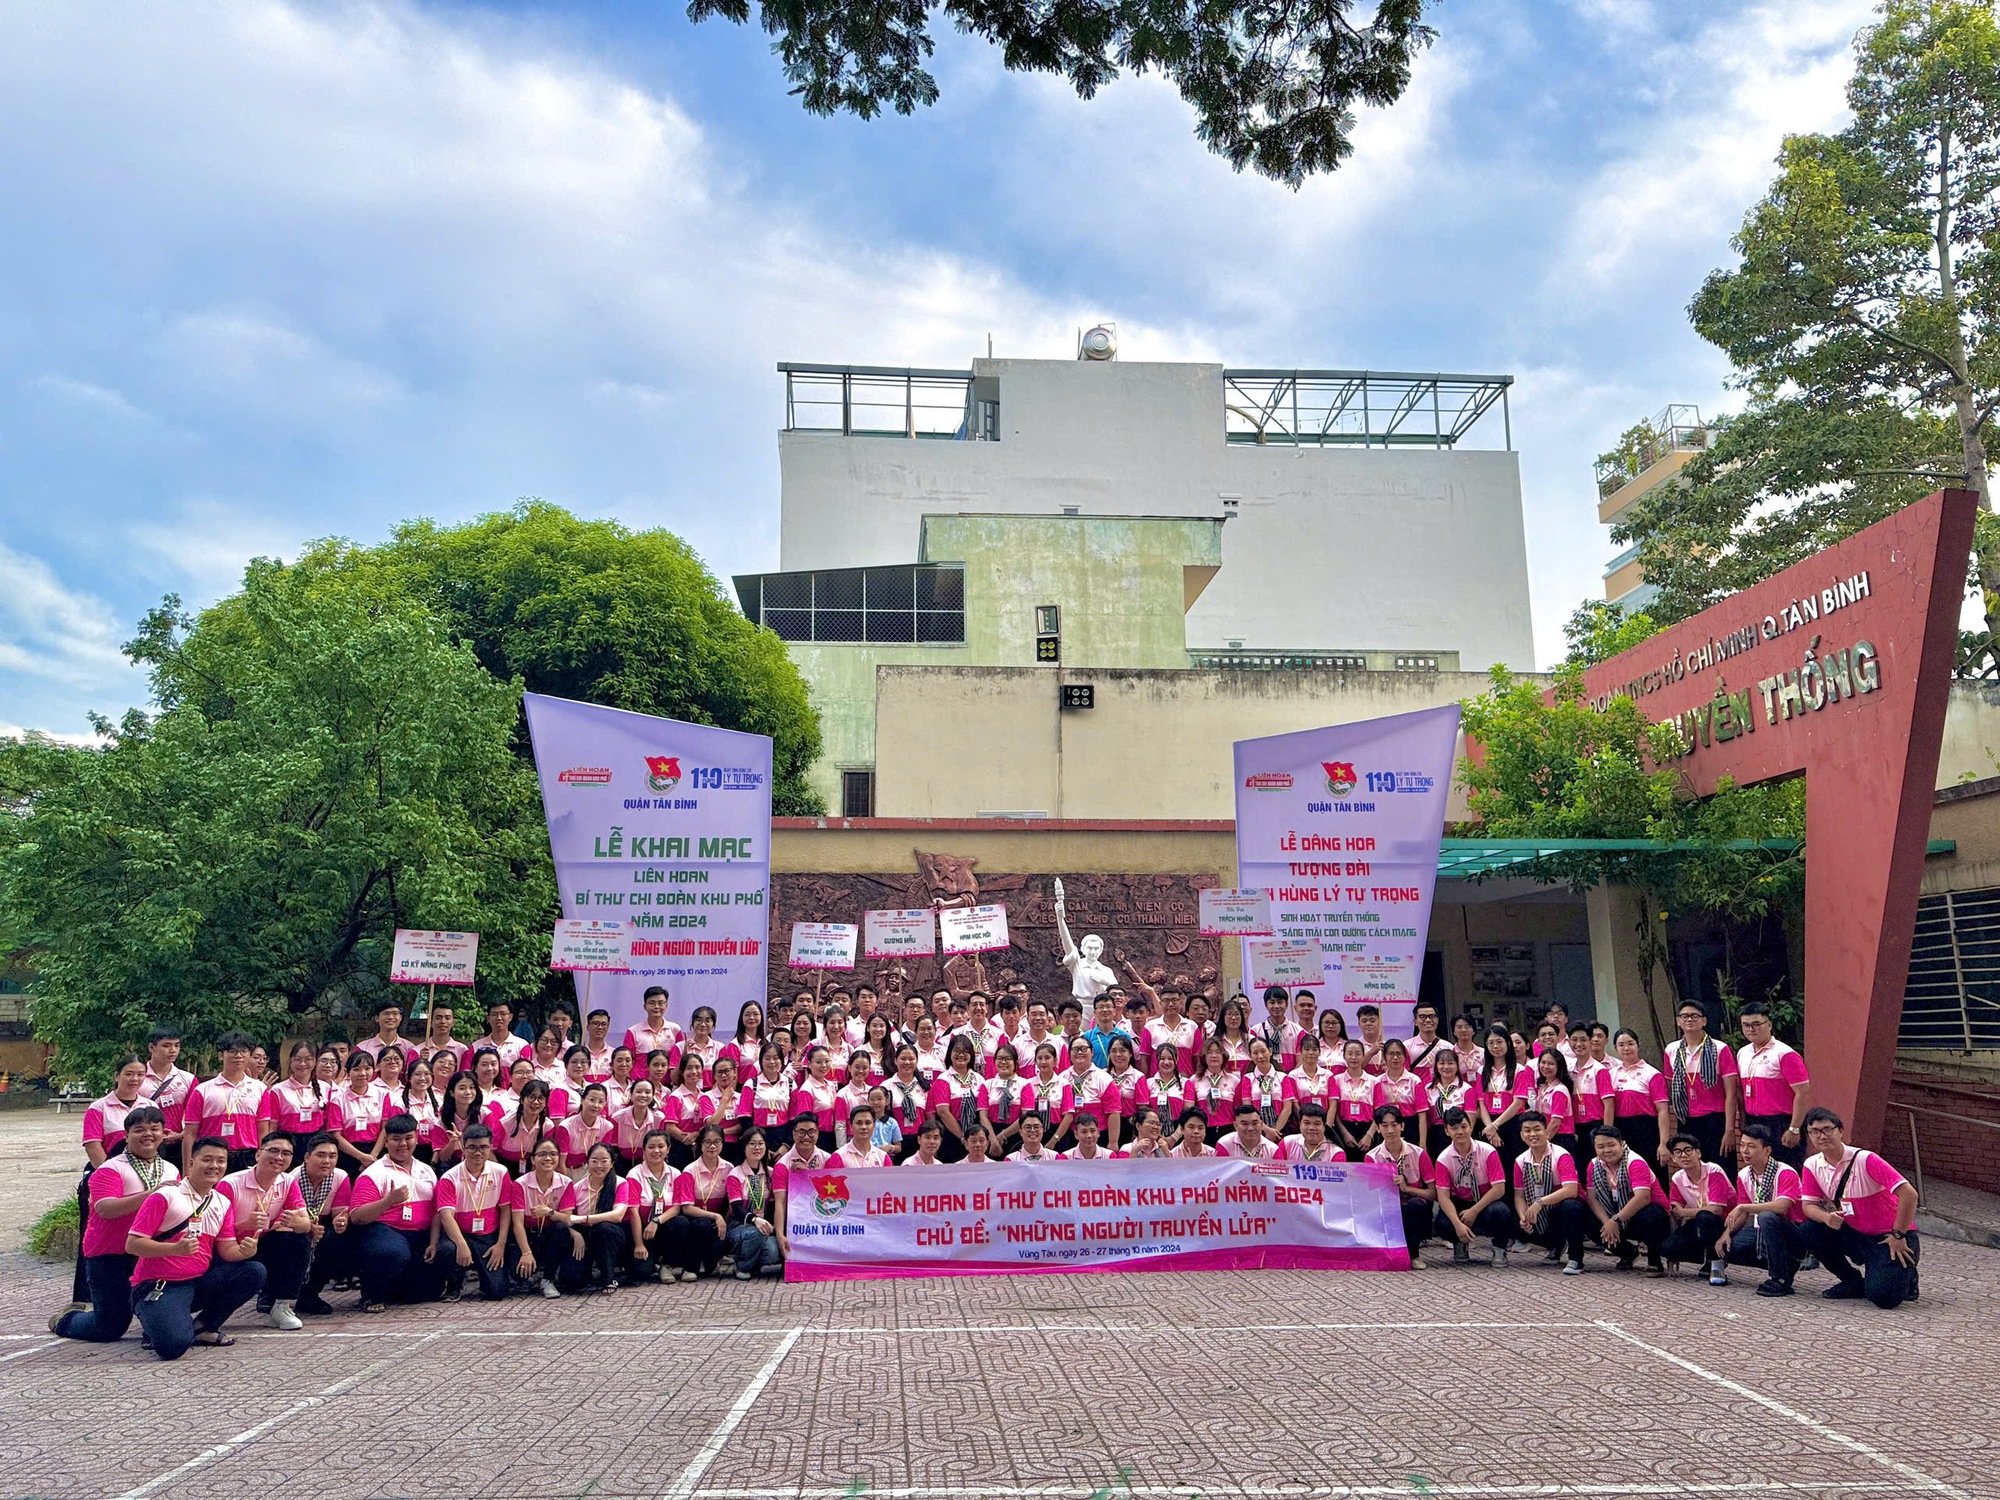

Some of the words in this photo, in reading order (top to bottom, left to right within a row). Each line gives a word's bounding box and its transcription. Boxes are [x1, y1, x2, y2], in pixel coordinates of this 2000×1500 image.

[1662, 647, 1685, 686] HỒ
[1686, 637, 1716, 674] CHÍ
[1716, 623, 1760, 662] MINH
[1822, 571, 1872, 615] BÌNH
[1658, 676, 1755, 757] UYỀN
[1757, 635, 1883, 726] THỐNG
[691, 768, 722, 789] 110
[1366, 772, 1396, 792] 110
[624, 798, 650, 812] QUẬN
[653, 797, 671, 809] TÂN
[674, 798, 698, 809] BÌNH
[1307, 801, 1332, 814] QUẬN
[1334, 801, 1351, 812] TÂN
[1354, 801, 1375, 812] BÌNH
[594, 826, 624, 857] LỄ
[631, 837, 690, 857] KHAI
[698, 837, 752, 863] MẠC
[1280, 830, 1297, 851] LỄ
[1301, 833, 1341, 851] DÂNG
[1346, 837, 1376, 851] HOA
[634, 868, 664, 883] LIÊN
[669, 871, 709, 883] HOAN
[1289, 862, 1341, 879] TƯỢNG
[1345, 859, 1370, 876] ĐÀI
[575, 889, 591, 905] BÍ
[594, 893, 625, 905] THƯ
[629, 893, 651, 905] CHI
[656, 889, 696, 905] ĐOÀN
[701, 893, 730, 905] KHU
[734, 888, 765, 905] PHỐ
[1279, 884, 1319, 901] HÙNG
[1323, 884, 1341, 901] LÝ
[1345, 888, 1366, 904] TỰ
[1370, 888, 1419, 904] TRỌNG
[631, 912, 664, 928] NĂM
[669, 915, 707, 928] 2024
[1136, 914, 1166, 925] THANH
[1299, 914, 1321, 923] HOẠT
[1324, 928, 1340, 937] CON
[1369, 927, 1390, 937] CÁCH
[1392, 928, 1417, 938] MẠNG
[630, 938, 660, 956] HỮNG
[662, 938, 696, 956] NGƯỜI
[698, 936, 737, 956] TRUYỀN
[401, 959, 409, 968] CÓ
[667, 968, 685, 977] tháng
[1293, 1165, 1317, 1180] 110
[866, 1192, 907, 1215] LIÊN
[913, 1194, 966, 1213] HOAN
[973, 1187, 991, 1211] BÍ
[997, 1191, 1037, 1209] THƯ
[1043, 1190, 1072, 1208] CHI
[1078, 1184, 1131, 1207] ĐOÀN
[1136, 1188, 1175, 1206] KHU
[1182, 1179, 1220, 1205] PHỐ
[1225, 1181, 1267, 1203] NĂM
[1274, 1188, 1324, 1205] 2024
[792, 1223, 818, 1237] QUẬN
[821, 1223, 840, 1235] TÂN
[842, 1223, 865, 1235] BÌNH
[916, 1222, 951, 1246] CHỦ
[960, 1217, 990, 1244] ĐỀ:
[1082, 1217, 1144, 1240] NGƯỜI
[1150, 1211, 1222, 1238] TRUYỀN
[1018, 1249, 1039, 1260] Vũng
[1059, 1249, 1078, 1260] ngày
[1080, 1248, 1090, 1256] 26
[1097, 1247, 1107, 1255] 27
[1108, 1246, 1131, 1257] tháng
[1132, 1245, 1140, 1254] 10
[1142, 1245, 1159, 1254] năm
[1161, 1244, 1181, 1252] 2024
